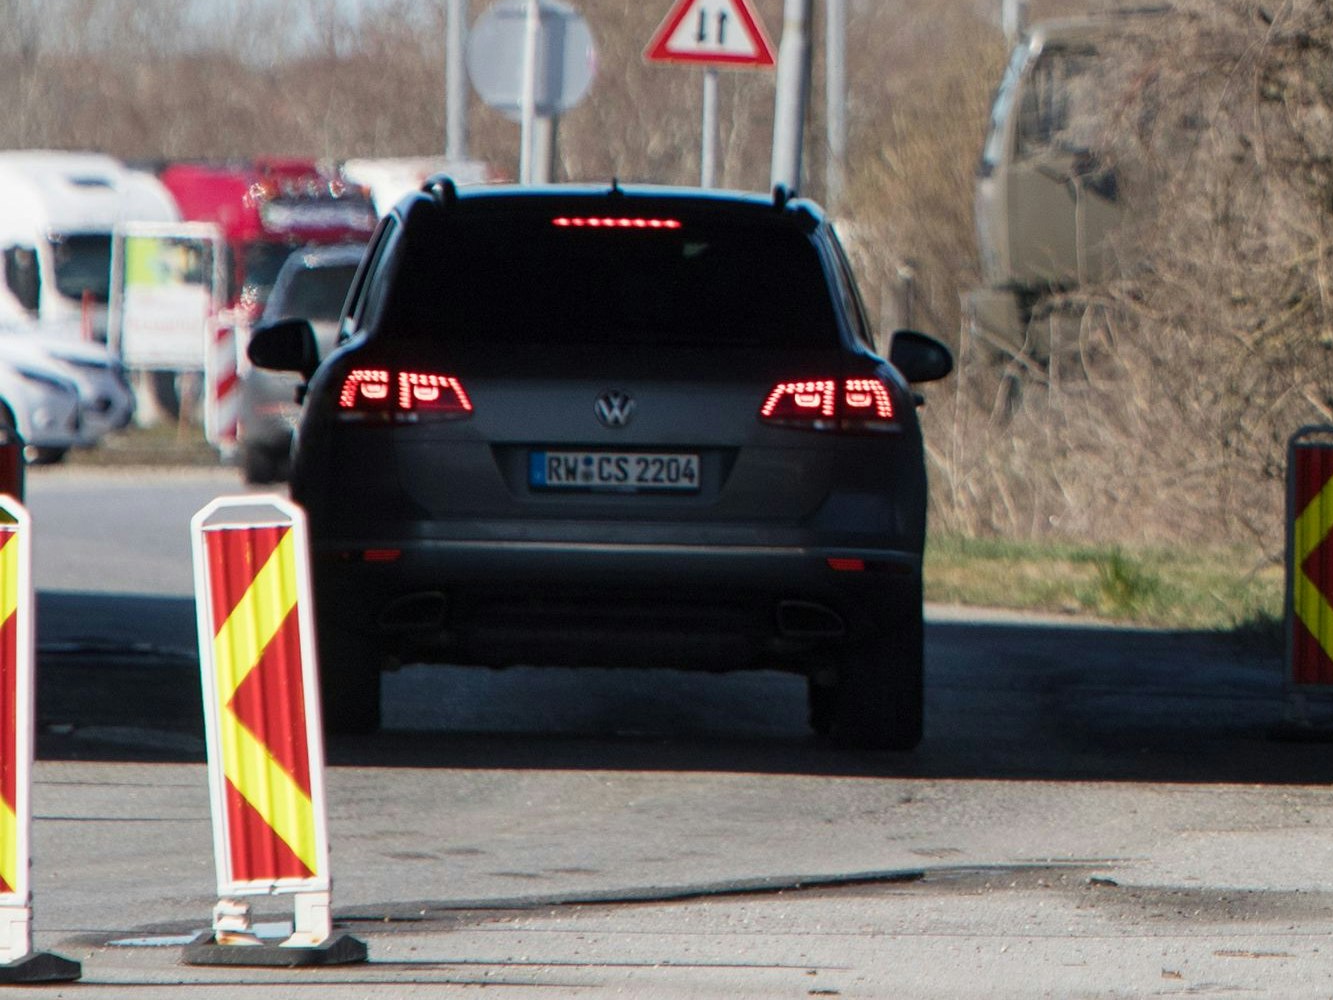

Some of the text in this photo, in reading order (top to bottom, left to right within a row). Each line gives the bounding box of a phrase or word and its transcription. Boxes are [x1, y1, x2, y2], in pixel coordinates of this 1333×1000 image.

[548, 456, 578, 482] RW
[598, 456, 628, 482] CS
[636, 457, 695, 483] 2204
